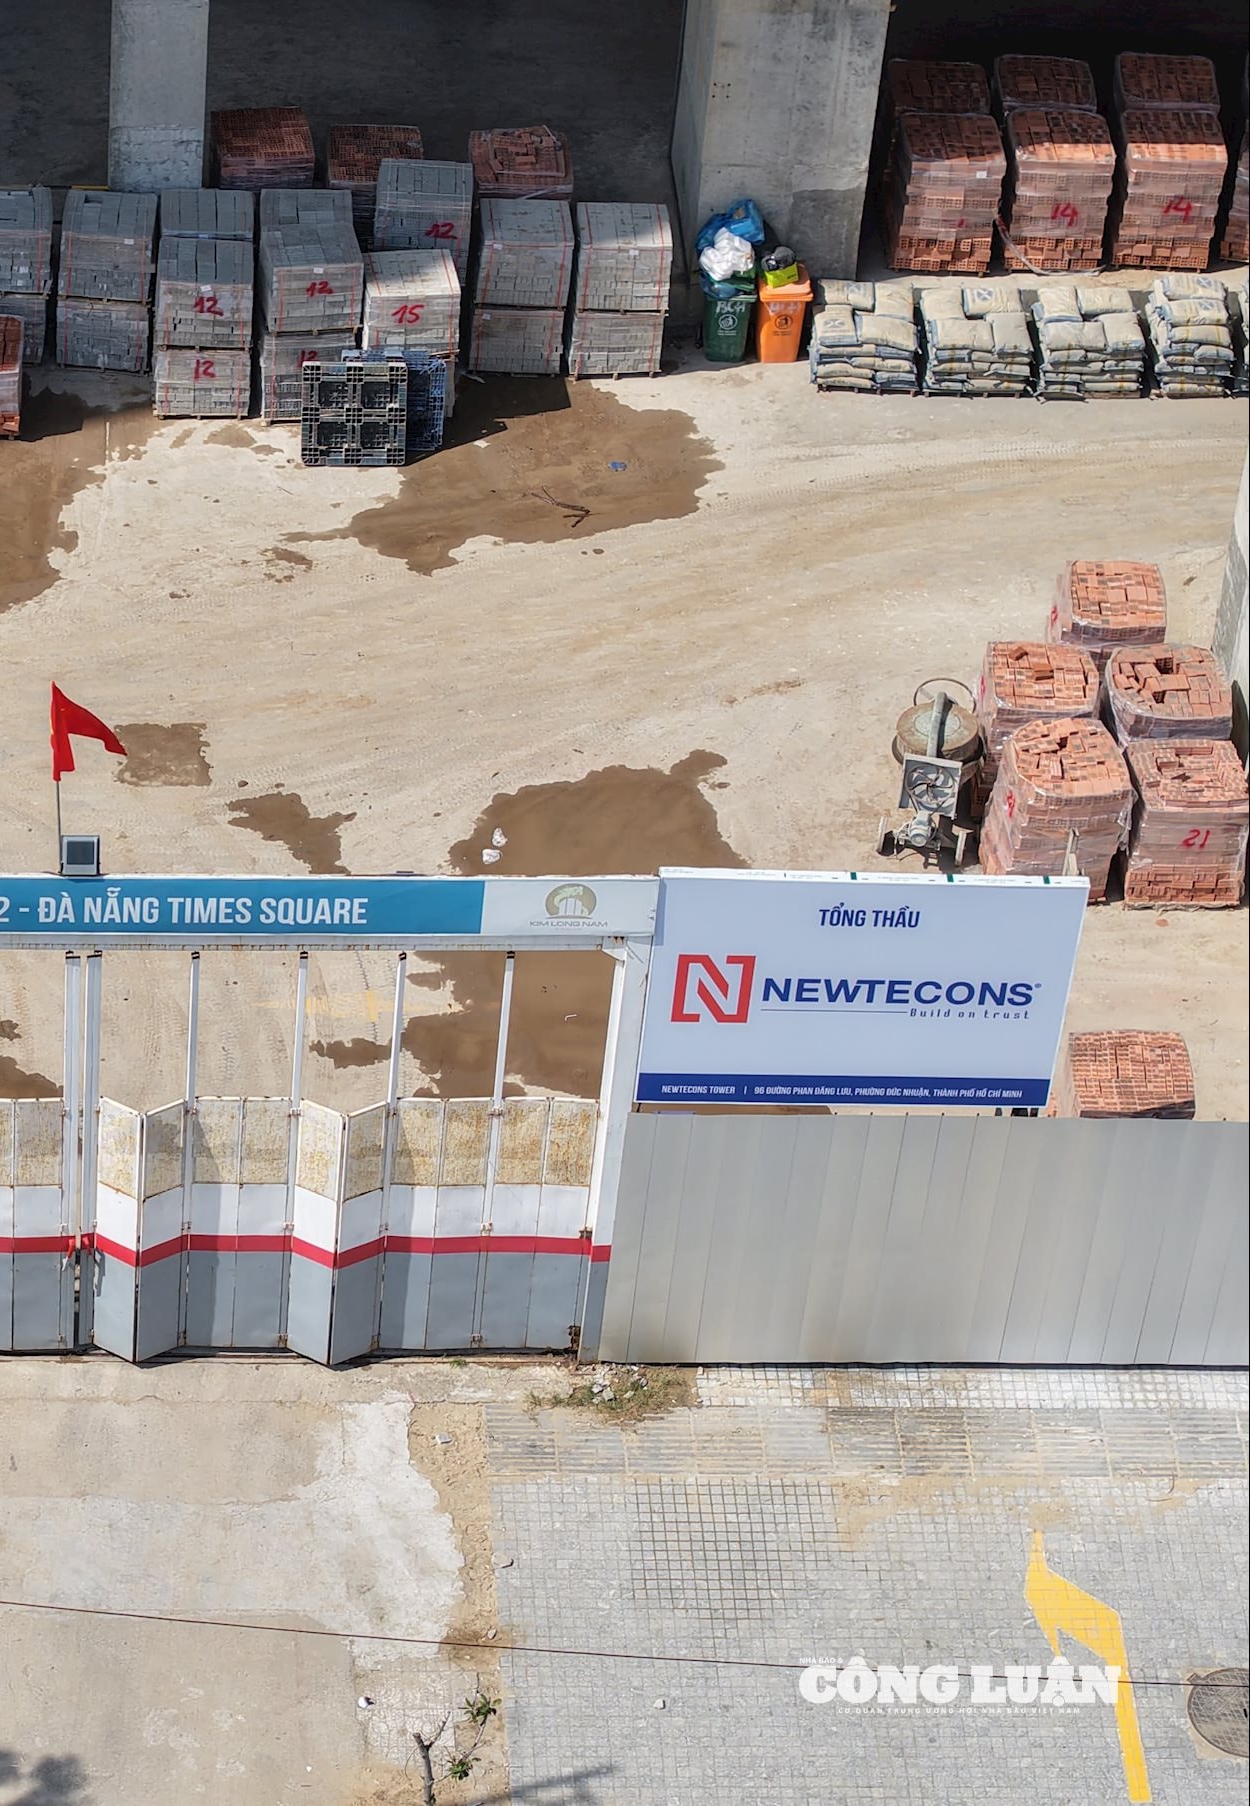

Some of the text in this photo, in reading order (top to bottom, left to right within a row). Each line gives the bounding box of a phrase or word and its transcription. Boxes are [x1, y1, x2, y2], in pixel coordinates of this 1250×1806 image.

[1051, 203, 1078, 226] 14
[1164, 197, 1193, 224] 14
[425, 222, 457, 241] 12
[306, 280, 334, 296] 12
[193, 295, 223, 317] 12
[391, 304, 424, 324] 15
[193, 359, 216, 379] 12
[1182, 829, 1211, 848] 21
[37, 892, 75, 923] ĐÀ
[83, 887, 160, 924] NẴNG
[167, 898, 252, 924] TIMES
[259, 898, 369, 926] SQUARE
[818, 902, 921, 929] TỔNG THẦU
[909, 1007, 1029, 1020] Build on trust
[661, 1085, 735, 1095] NEWTECONS TOWER
